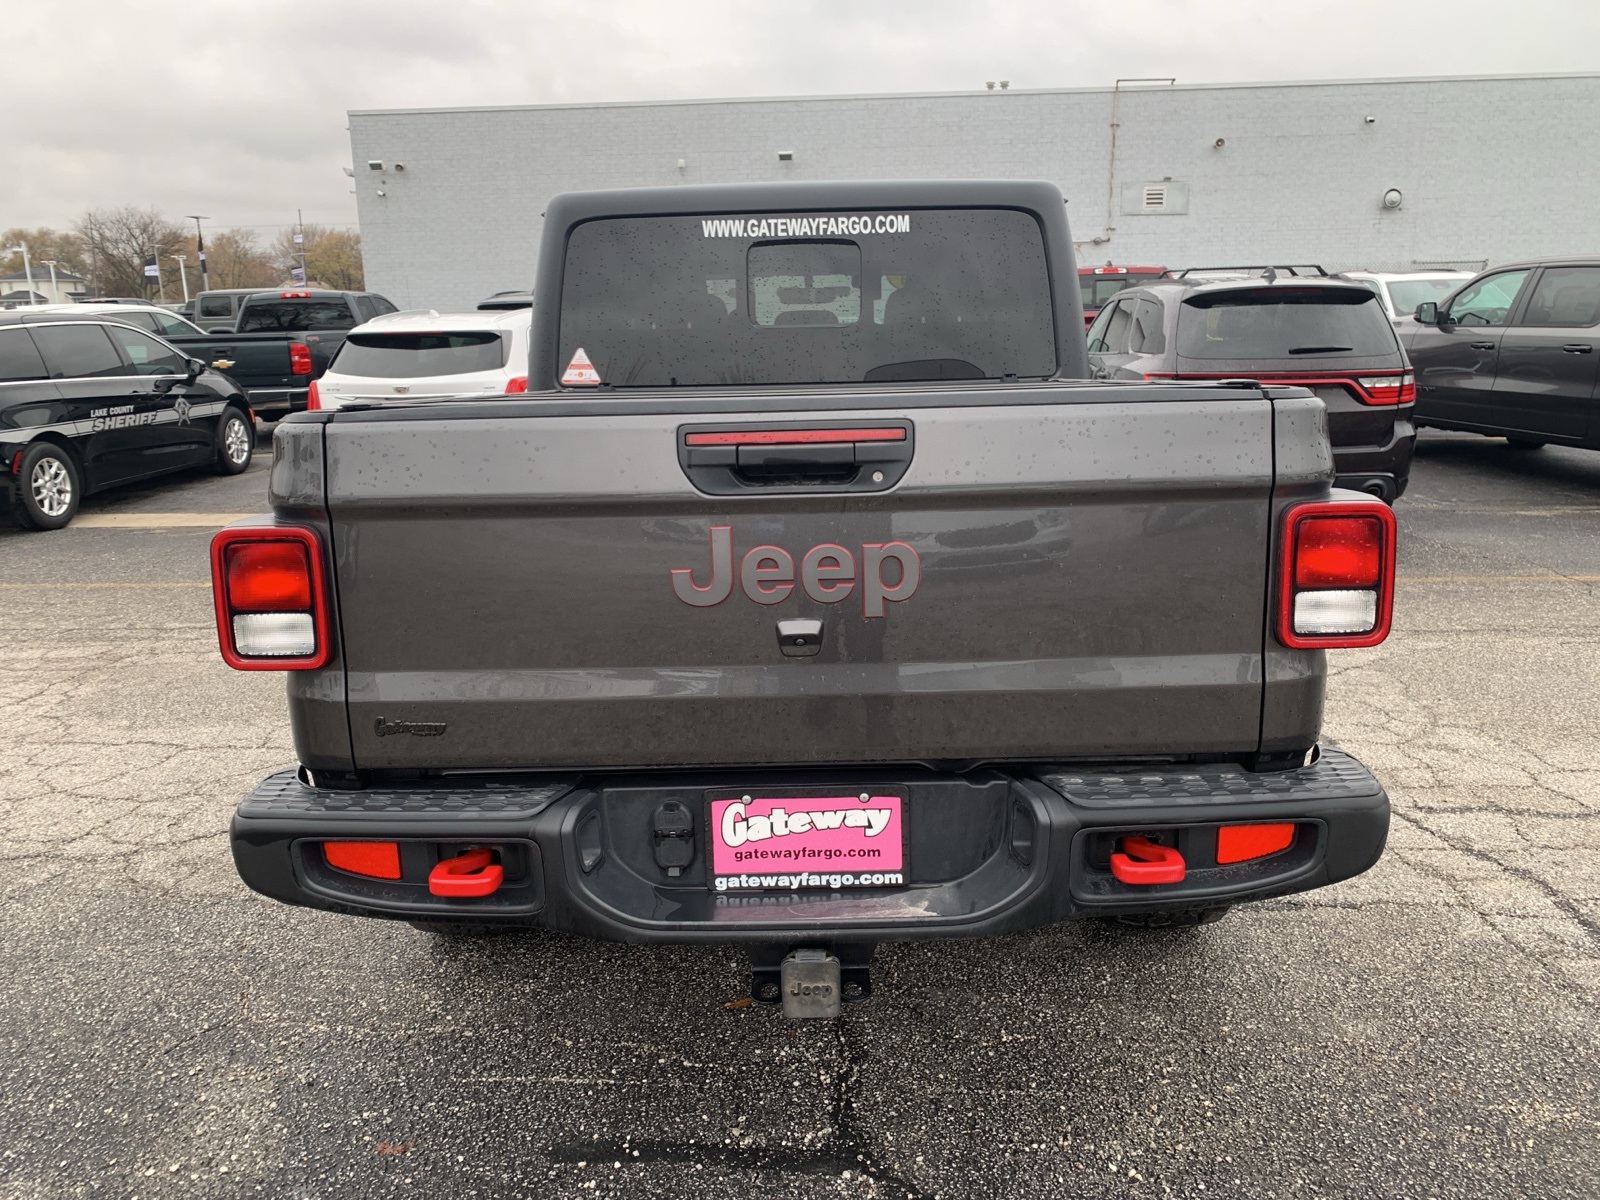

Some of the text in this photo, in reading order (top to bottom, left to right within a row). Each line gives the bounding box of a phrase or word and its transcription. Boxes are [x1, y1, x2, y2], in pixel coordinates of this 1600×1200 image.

[702, 215, 910, 238] WWW.GATEWAYFARGO.COM
[90, 405, 135, 418] LAKE COUNTY
[93, 411, 157, 431] SHERIFF
[670, 526, 921, 618] Jeep
[721, 801, 892, 848] Gateway
[734, 847, 881, 862] gatewayfargo.com
[715, 872, 903, 891] gatewayfargo.com
[790, 982, 833, 998] Jeep
